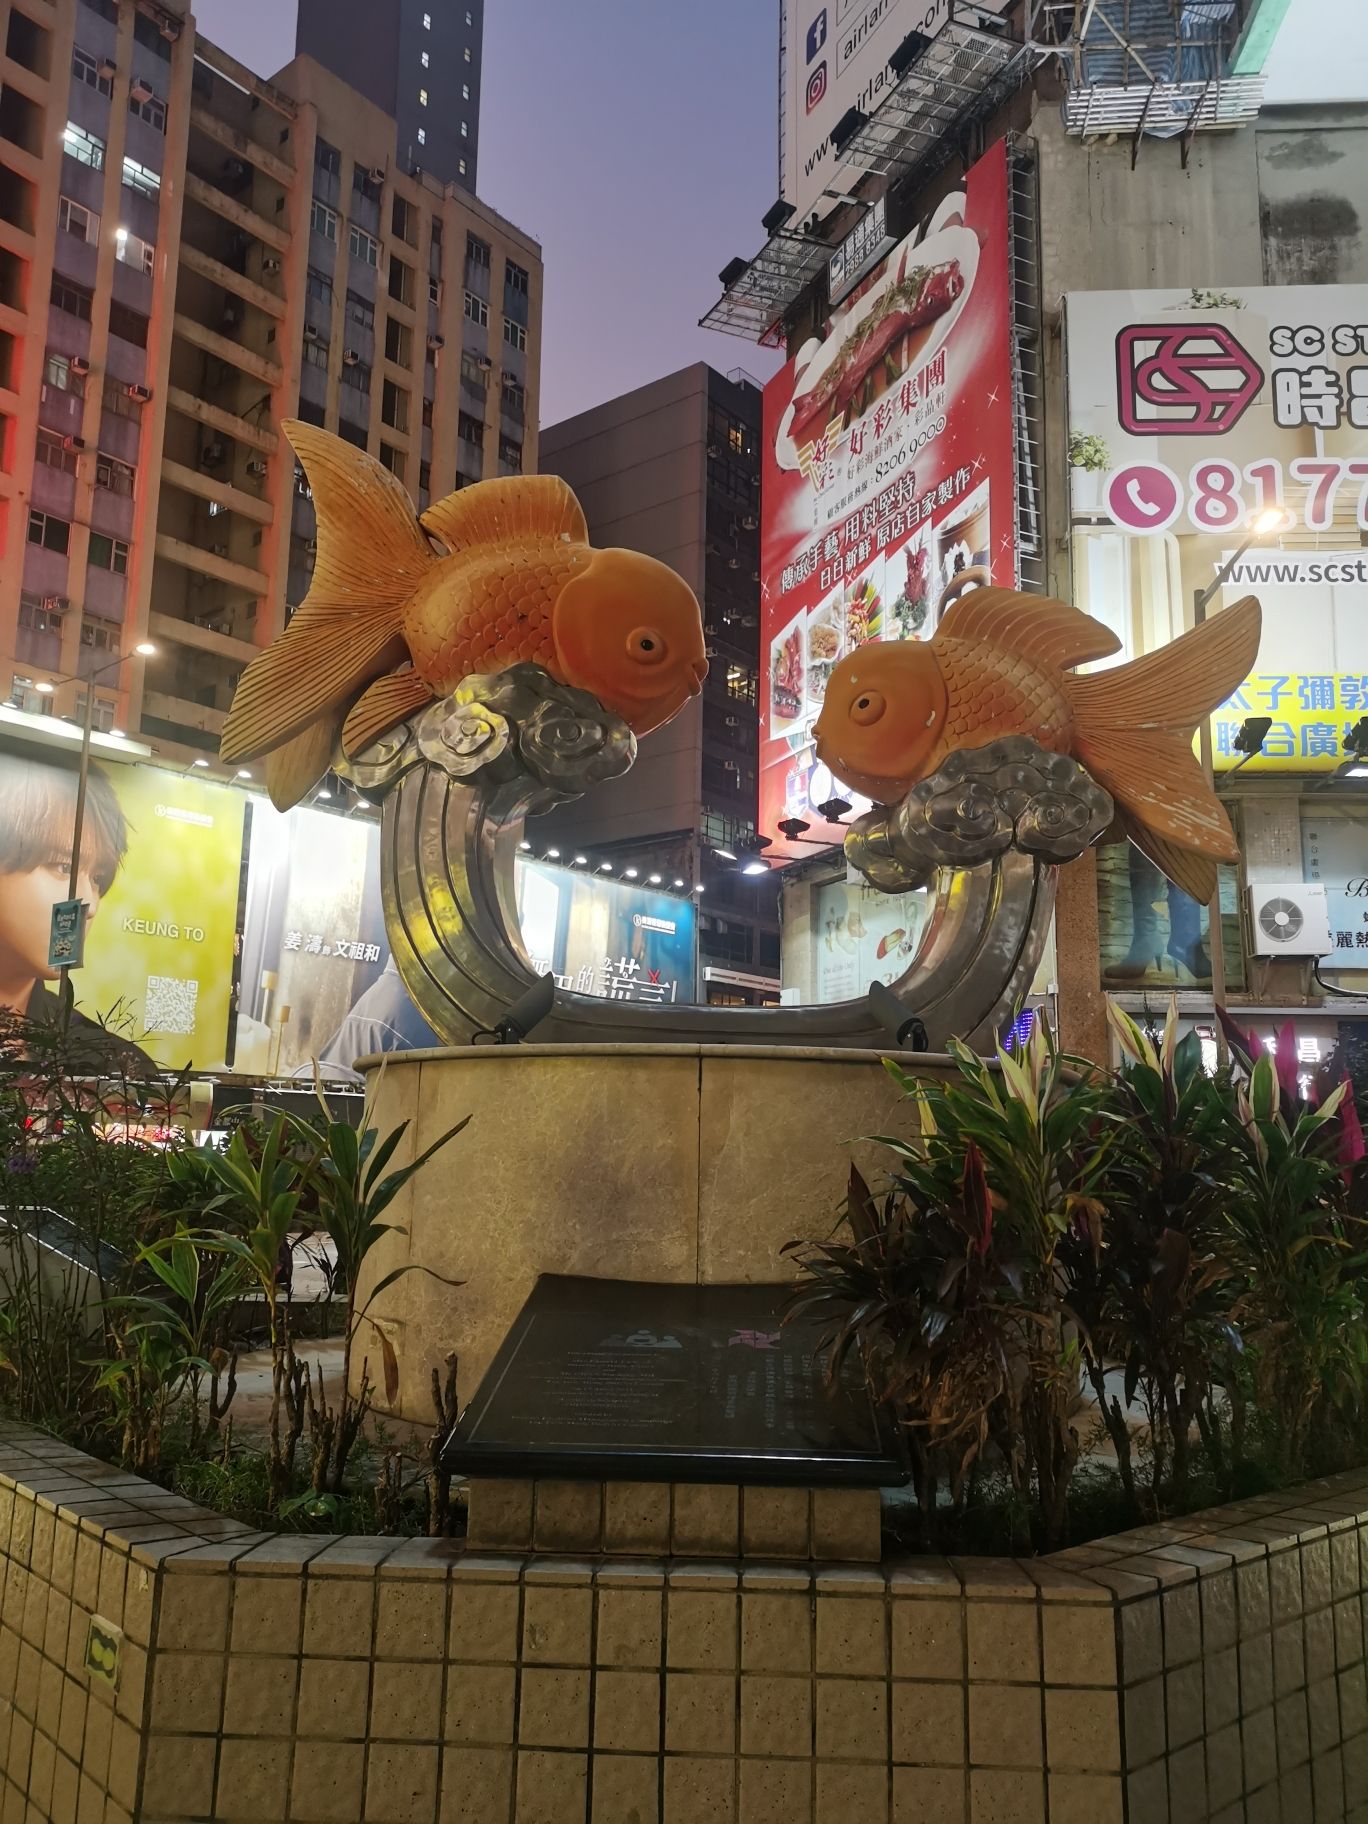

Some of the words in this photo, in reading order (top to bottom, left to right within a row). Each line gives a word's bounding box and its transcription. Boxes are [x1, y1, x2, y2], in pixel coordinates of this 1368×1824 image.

[1270, 325, 1325, 357] SC
[850, 350, 945, 464] 好彩集團
[1271, 365, 1368, 430] 時
[820, 536, 872, 590] 日日新鮮
[876, 466, 971, 550] 原店自家製作
[844, 471, 917, 545] 用料堅持
[122, 917, 180, 941] KEUNG
[183, 925, 206, 943] TO
